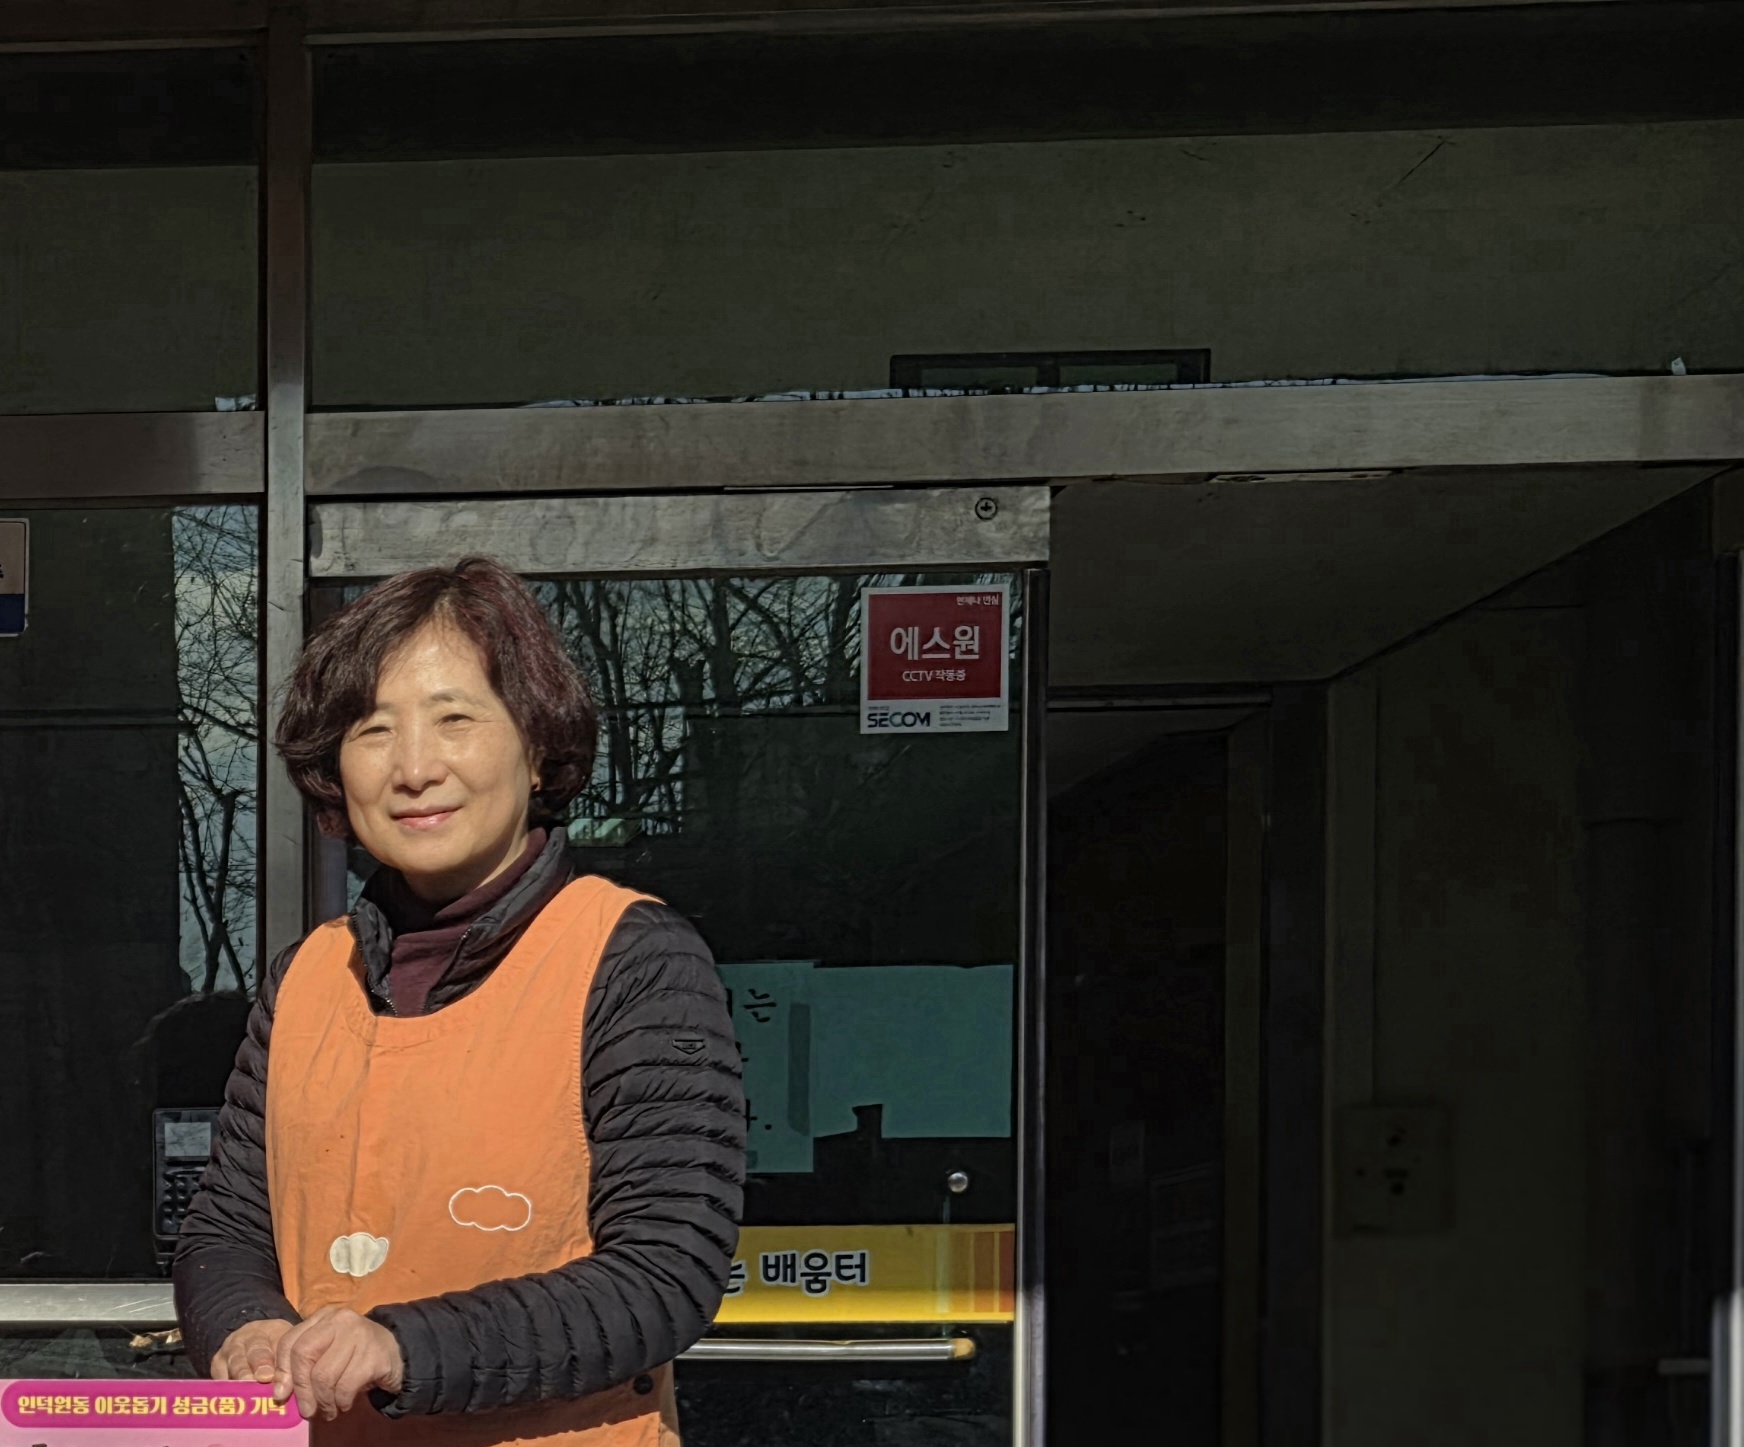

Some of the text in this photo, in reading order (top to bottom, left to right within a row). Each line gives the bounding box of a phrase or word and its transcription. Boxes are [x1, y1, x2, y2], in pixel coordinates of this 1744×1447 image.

[890, 625, 979, 660] 에스원
[902, 670, 933, 682] CCTV
[867, 711, 931, 728] SECOM
[761, 1251, 867, 1294] 배움터
[18, 1396, 90, 1414] 인덕원동
[95, 1396, 167, 1415] 이웃돕기
